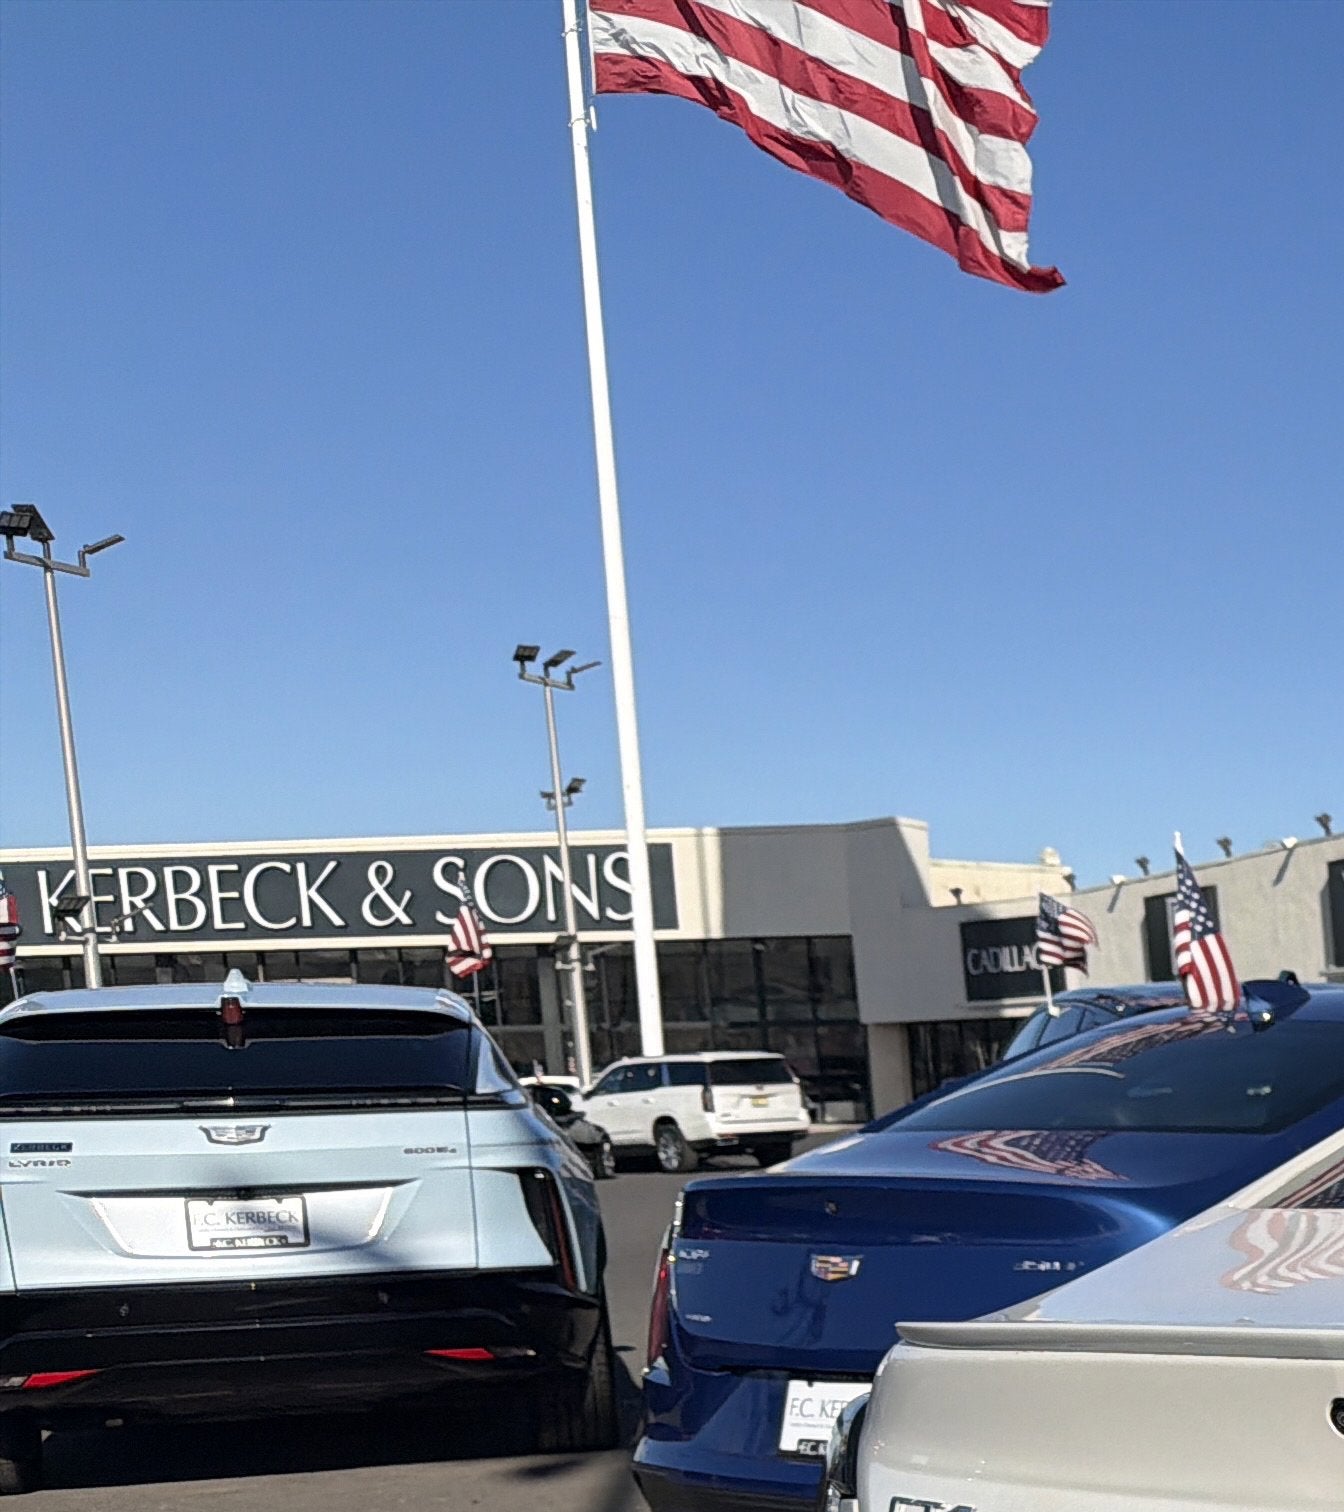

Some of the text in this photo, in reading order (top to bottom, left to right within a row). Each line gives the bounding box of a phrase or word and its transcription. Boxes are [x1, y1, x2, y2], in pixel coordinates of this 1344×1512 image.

[37, 851, 635, 934] KERBECK & SONS
[225, 1210, 299, 1226] KERBECK
